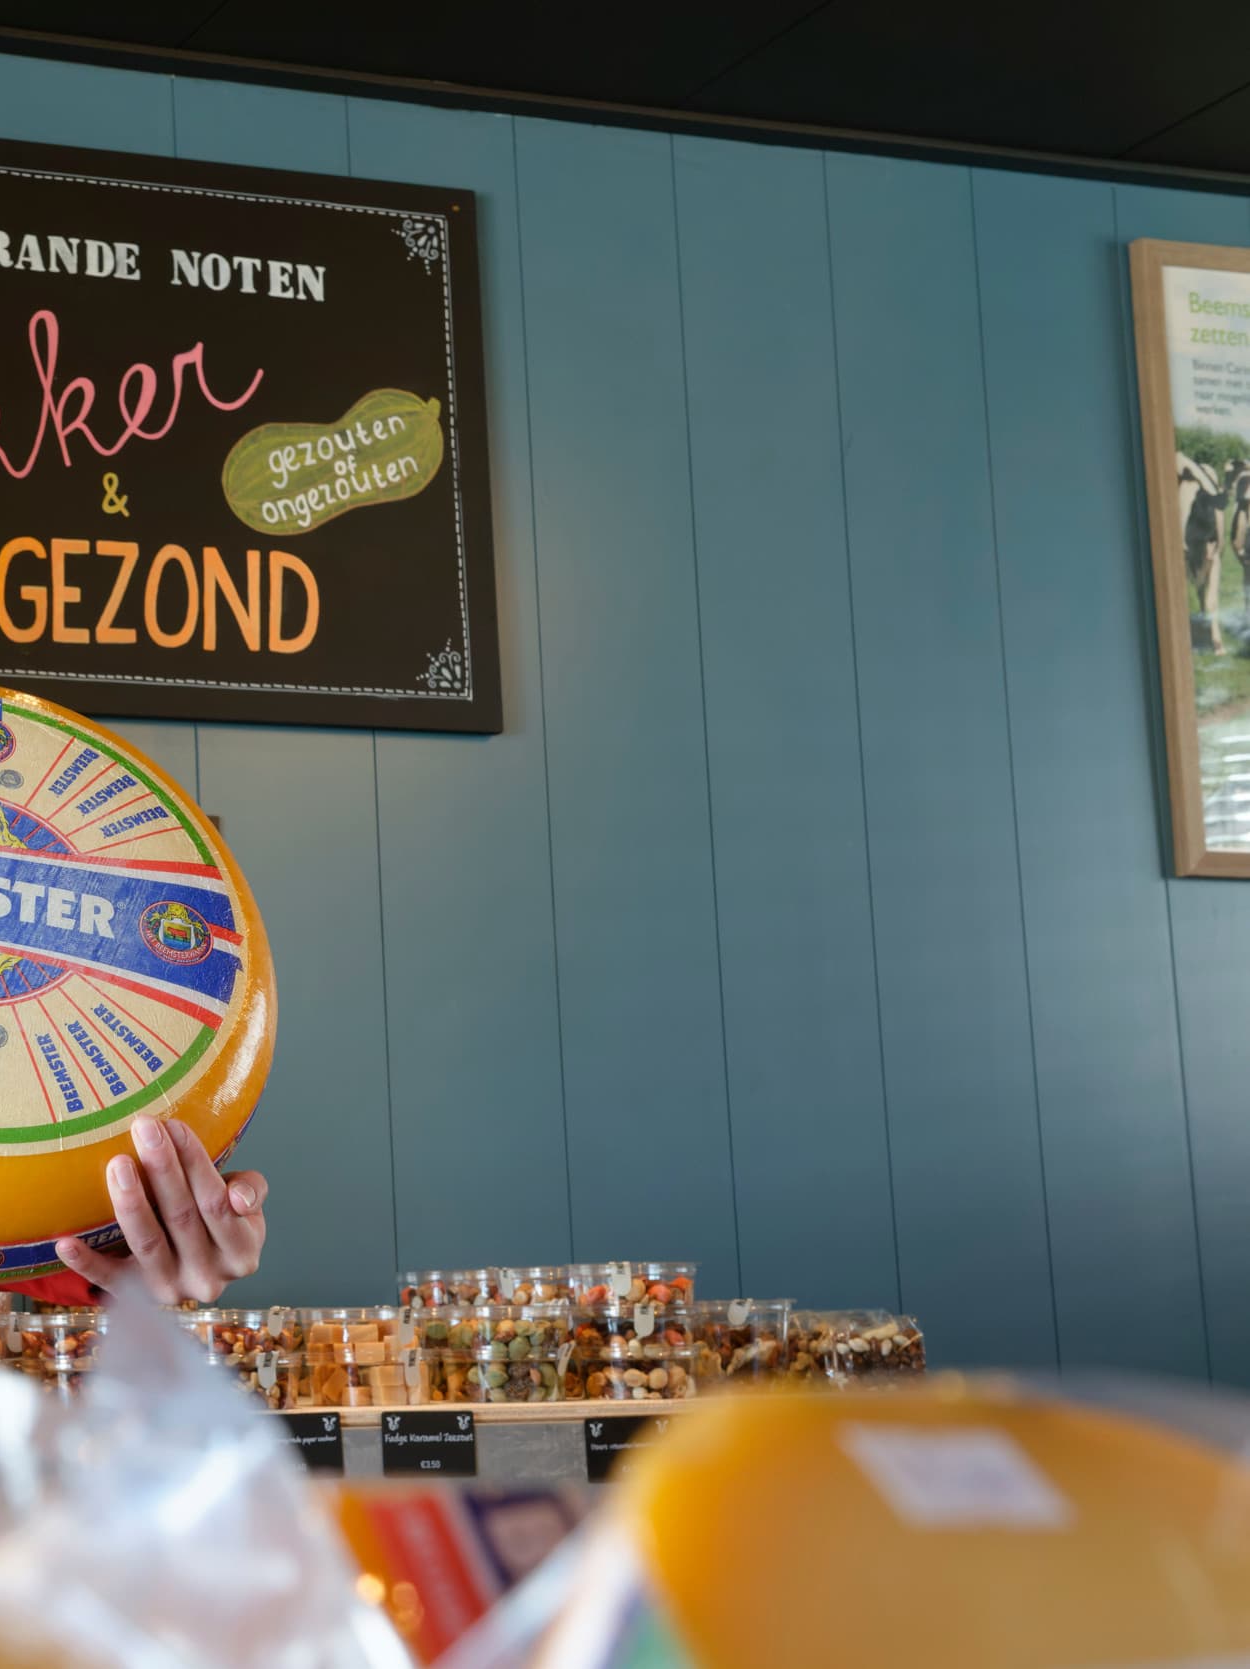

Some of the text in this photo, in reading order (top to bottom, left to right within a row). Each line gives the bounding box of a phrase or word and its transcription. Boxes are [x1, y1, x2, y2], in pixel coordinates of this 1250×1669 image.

[171, 249, 327, 302] NOTEN
[268, 415, 406, 489] gezouten
[334, 455, 357, 476] of
[101, 472, 130, 517] &
[262, 456, 419, 527] ongezouten
[48, 748, 100, 796] BEEMSTER
[75, 774, 138, 816] BEEMSTER
[100, 806, 169, 839] BEEMSTER
[67, 1020, 128, 1097] BEEMSTER
[93, 1003, 164, 1073] BEEMSTER
[36, 1033, 85, 1113] BEEMSTER
